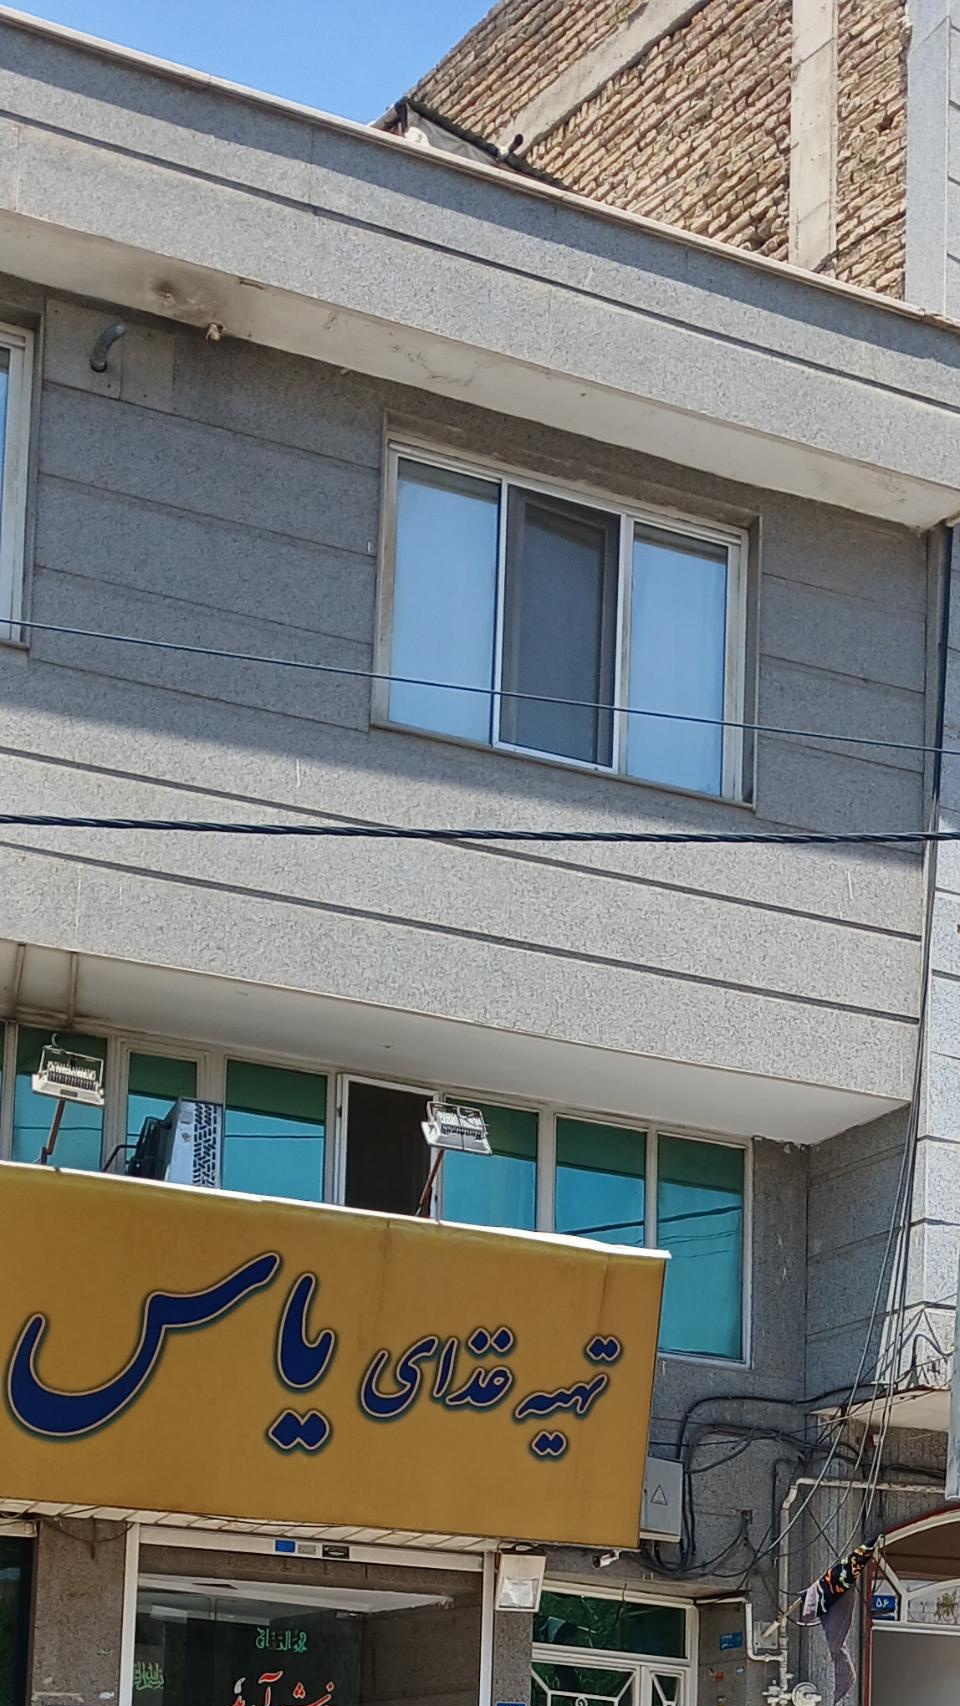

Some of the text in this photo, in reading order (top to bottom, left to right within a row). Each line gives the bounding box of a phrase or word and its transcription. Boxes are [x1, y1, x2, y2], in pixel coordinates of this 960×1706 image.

[7, 1251, 622, 1458] تهیه غذای یاس
